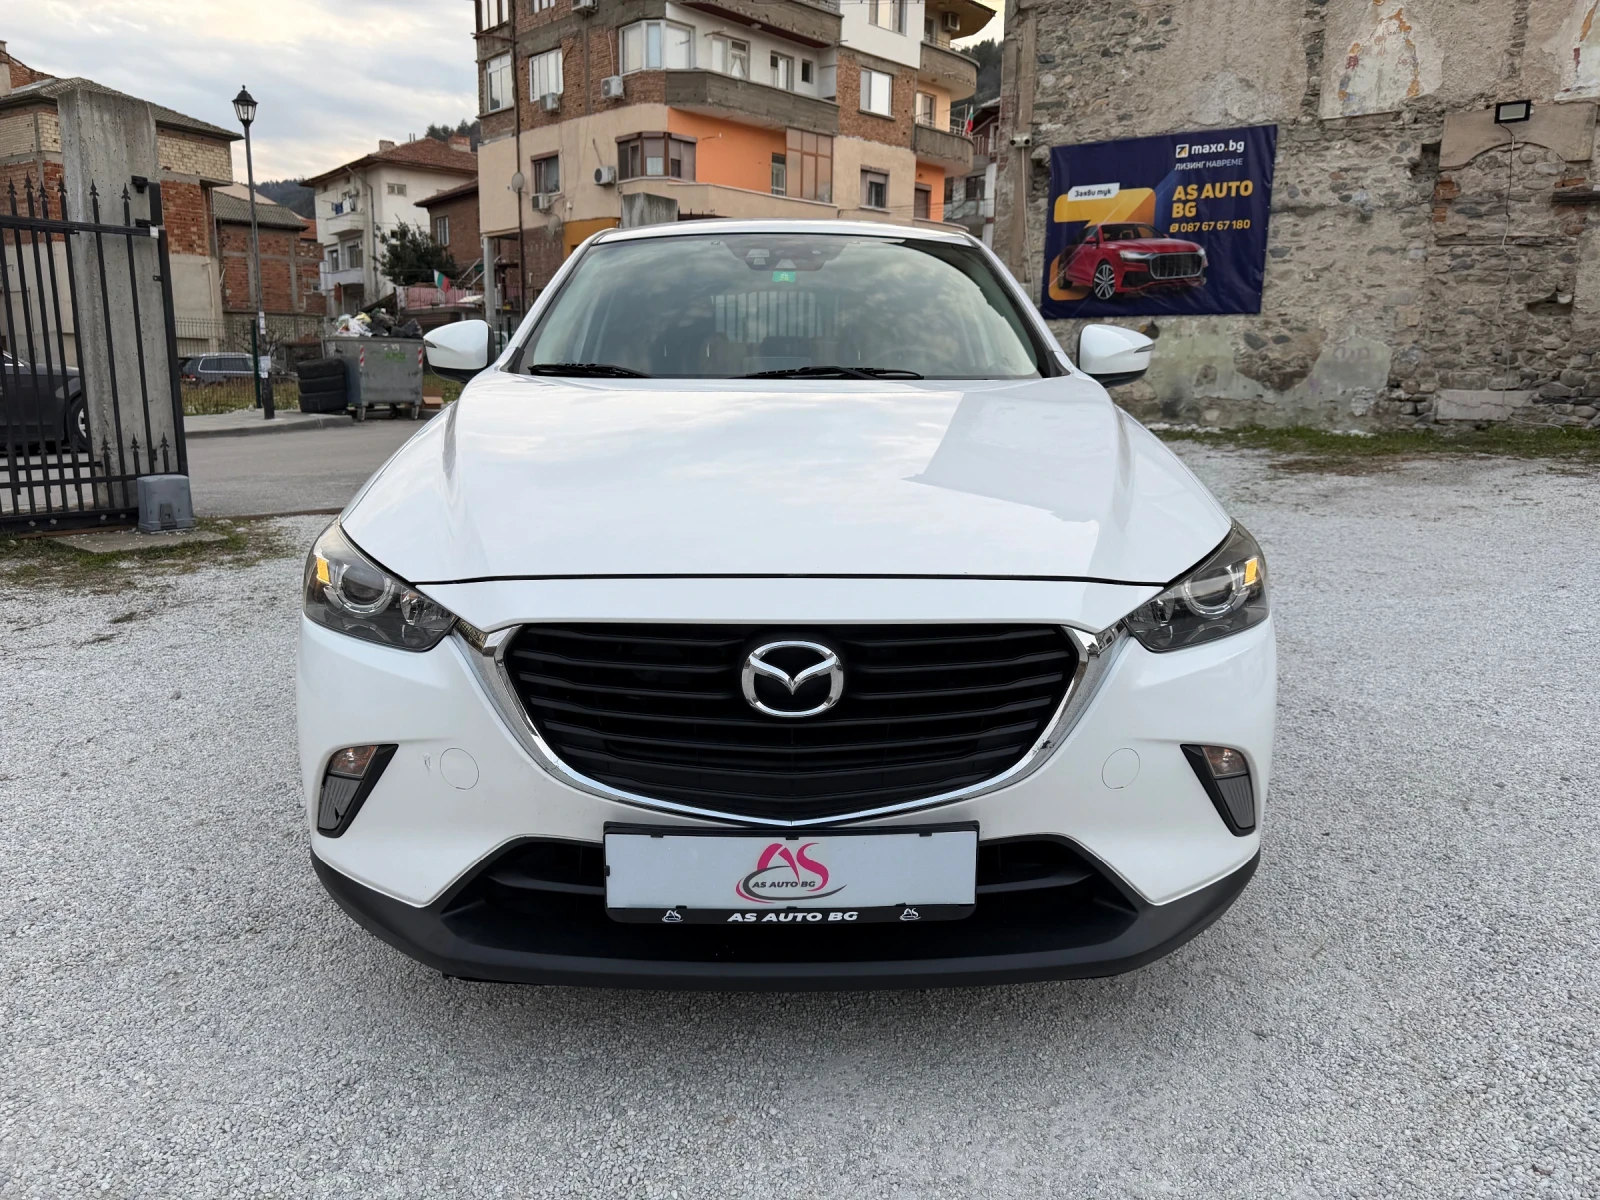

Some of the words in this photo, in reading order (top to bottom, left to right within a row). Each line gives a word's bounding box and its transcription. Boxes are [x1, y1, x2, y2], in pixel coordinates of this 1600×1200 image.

[1191, 140, 1245, 154] maxo.bg
[1175, 161, 1206, 171] ЛИЗИНГ
[1206, 158, 1244, 168] НАВРЕМЕ
[1172, 184, 1198, 200] AS
[1200, 180, 1253, 199] AUTO
[1172, 202, 1197, 218] BG
[1180, 222, 1200, 232] 087
[1202, 221, 1215, 231] 67
[1217, 220, 1230, 230] 67
[1232, 219, 1251, 229] 180
[757, 843, 829, 891] AS
[727, 912, 757, 922] AS
[761, 912, 823, 922] AUTO
[828, 911, 858, 921] BG
